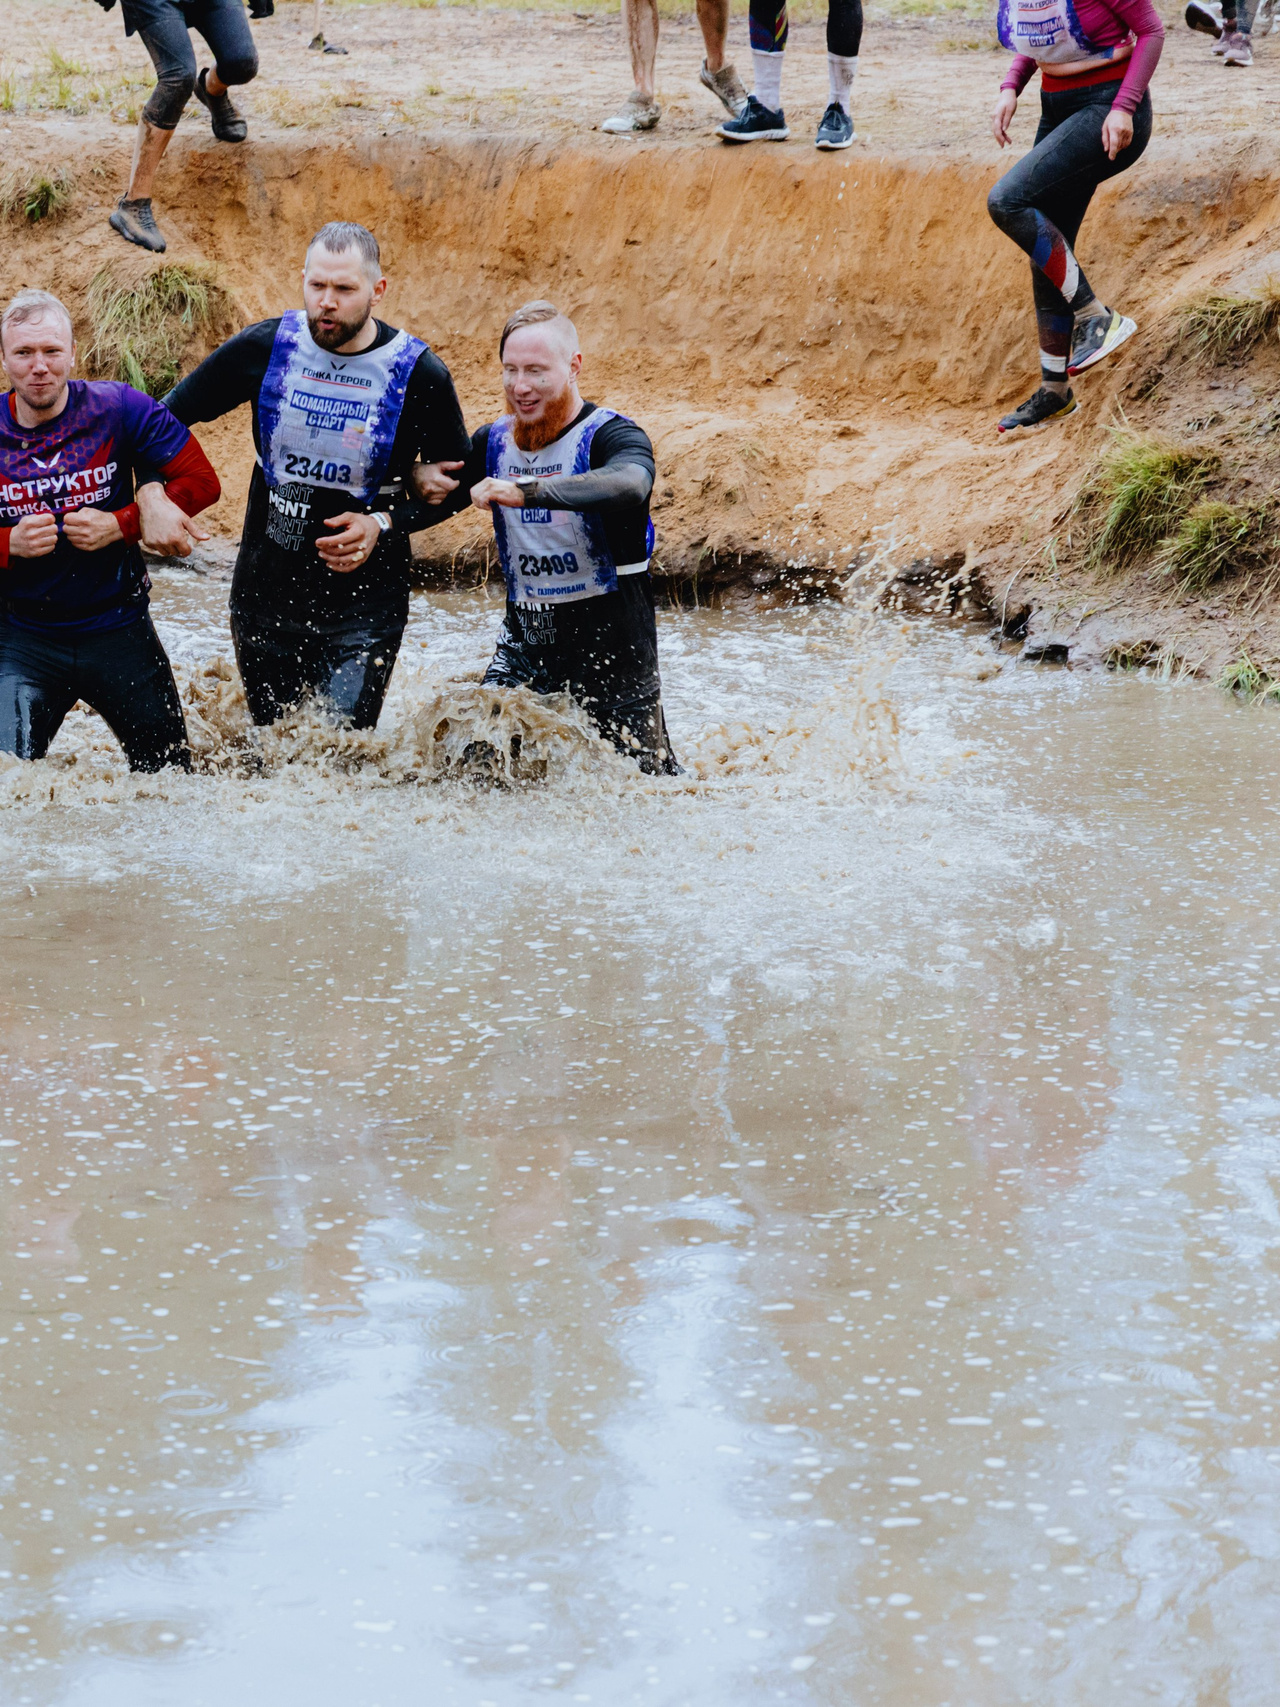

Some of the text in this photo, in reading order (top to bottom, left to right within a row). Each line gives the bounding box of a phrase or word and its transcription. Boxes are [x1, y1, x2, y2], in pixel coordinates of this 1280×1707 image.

[302, 367, 373, 388] ГОНКА ГЕРОЕВ
[291, 392, 369, 419] КОМАНДНЫЙ
[308, 413, 343, 430] СТАРТ
[284, 453, 352, 483] 23403
[54, 486, 111, 509] ГЕРОЕВ
[268, 489, 312, 519] MGNT
[522, 508, 549, 522] СТАРТ
[518, 551, 579, 577] 23409
[537, 583, 587, 596] ГАЗПРОМБАНК
